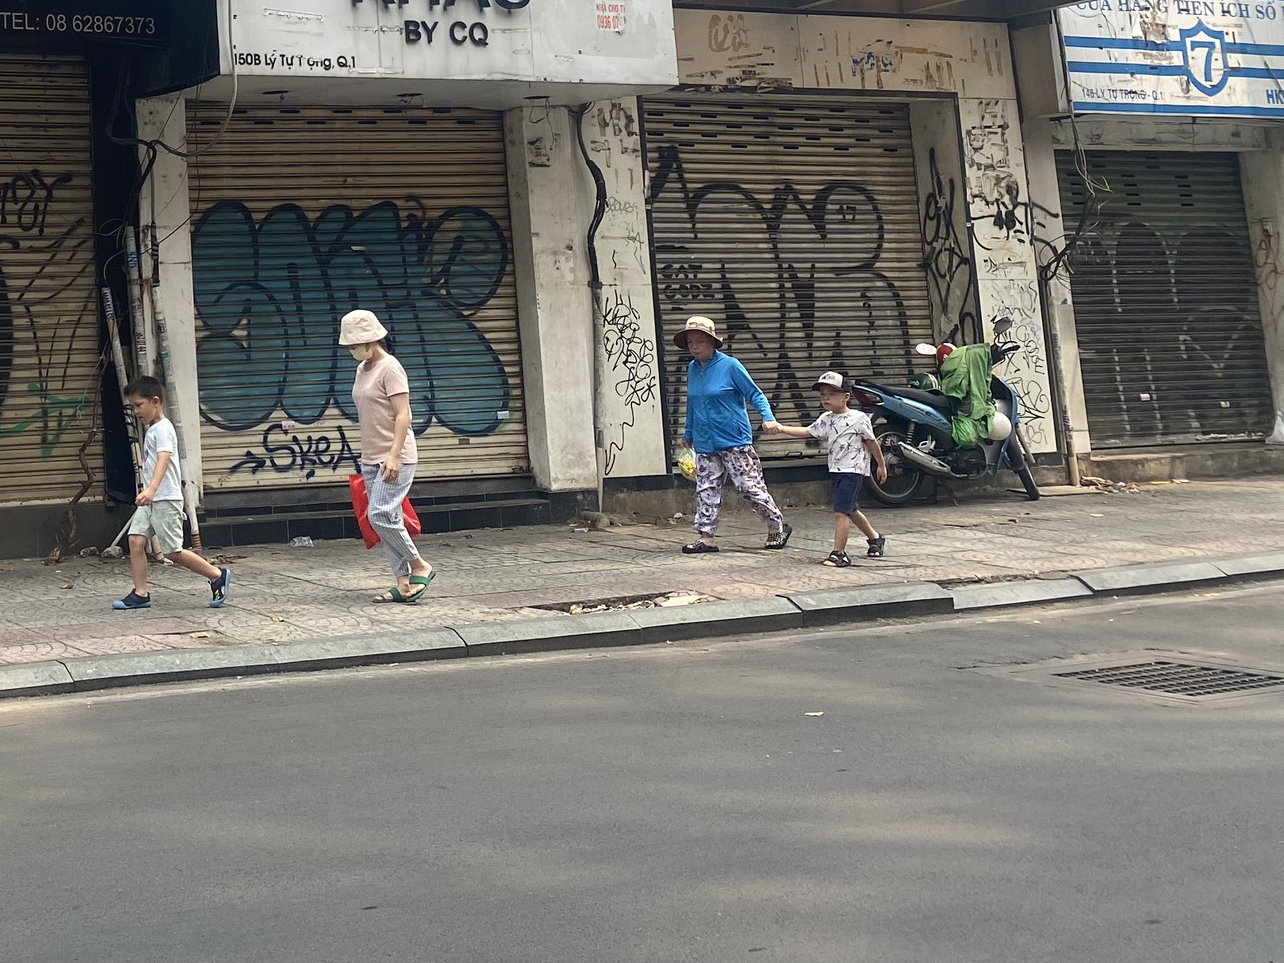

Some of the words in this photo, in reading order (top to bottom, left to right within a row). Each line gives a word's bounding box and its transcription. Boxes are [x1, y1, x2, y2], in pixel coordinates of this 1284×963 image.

[1255, 0, 1276, 20] SỐ
[0, 12, 40, 30] TEL:
[46, 13, 67, 31] 08
[72, 14, 156, 34] 62867373
[403, 20, 438, 45] BY
[448, 20, 489, 47] CQ
[234, 52, 262, 66] 150B
[336, 55, 356, 68] Q.1
[1190, 40, 1216, 82] 7
